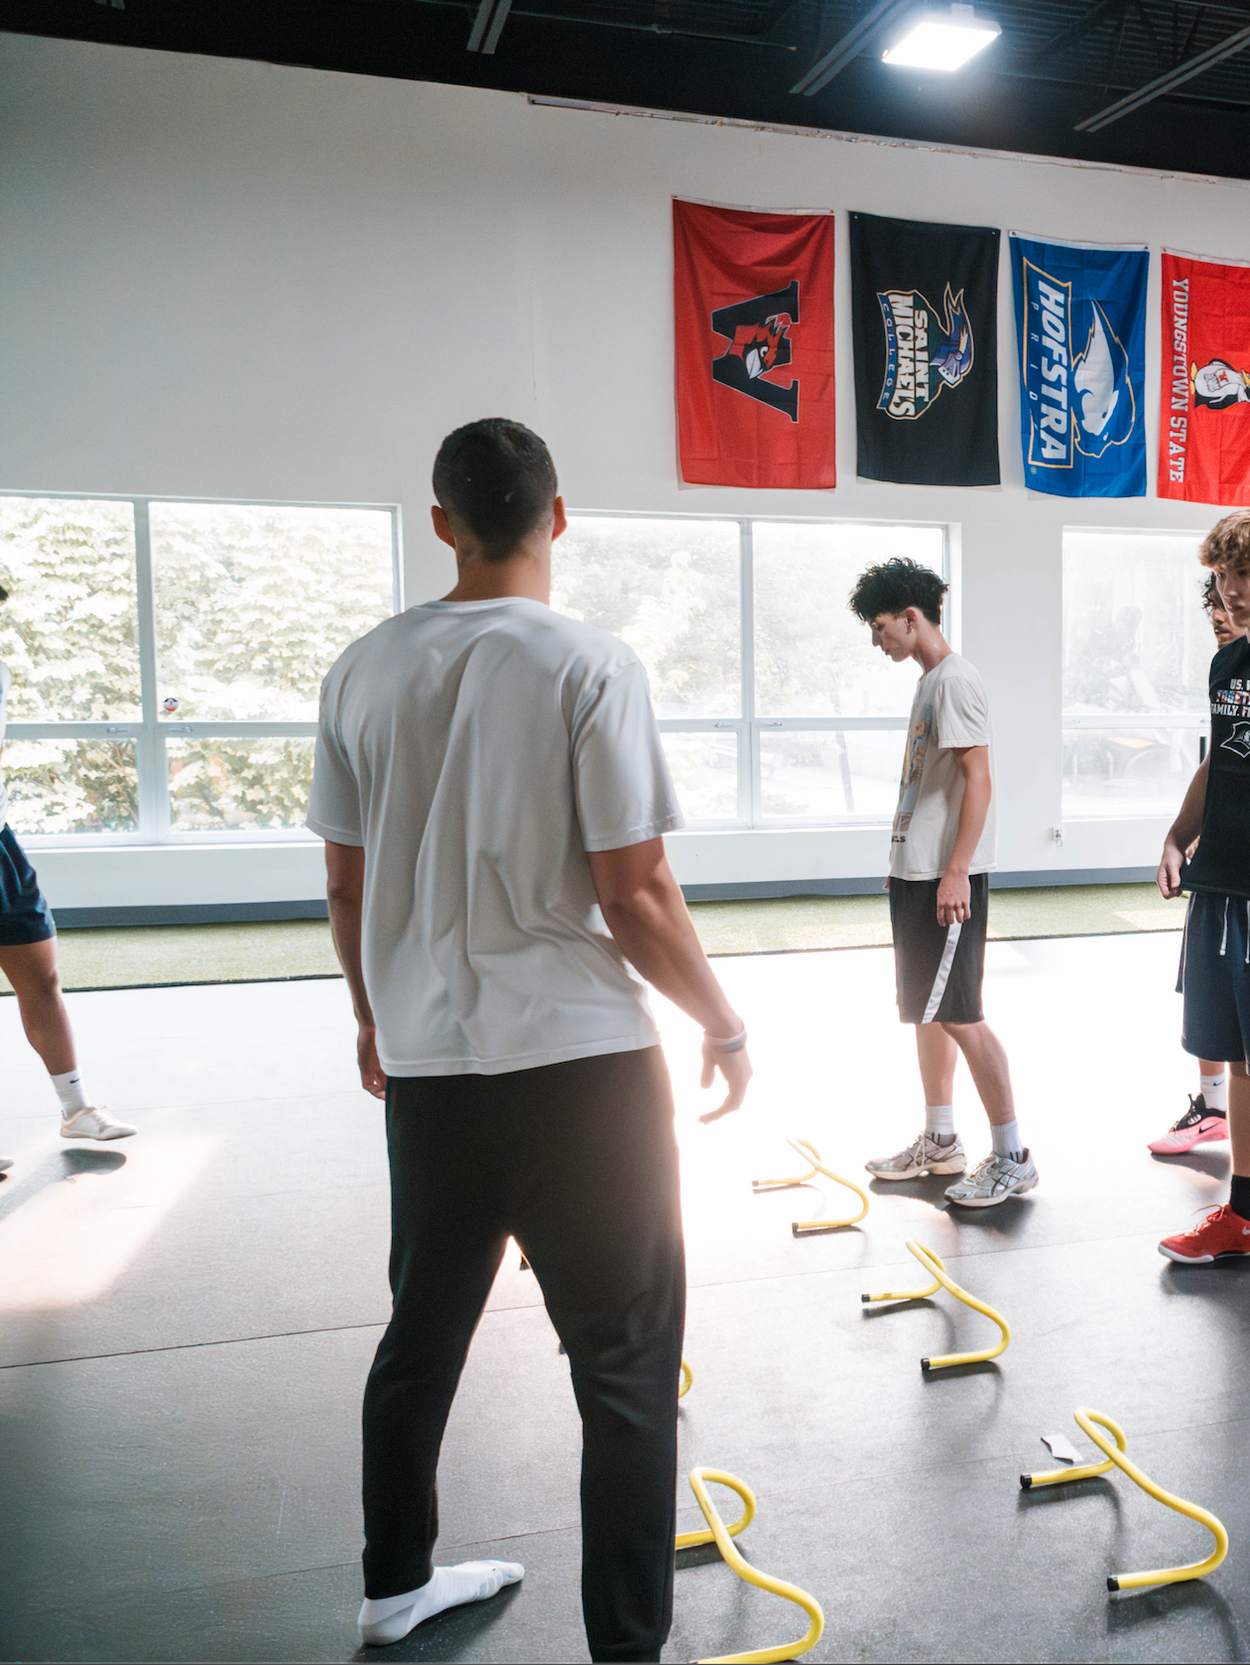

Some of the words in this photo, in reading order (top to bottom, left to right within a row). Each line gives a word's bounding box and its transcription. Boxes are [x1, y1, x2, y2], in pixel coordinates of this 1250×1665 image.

[883, 303, 896, 400] COLLEGE
[888, 294, 916, 416] MICHAELS
[914, 309, 929, 402] SAINT
[1029, 301, 1040, 430] PRID
[1038, 279, 1068, 460] HOFSTRA
[1171, 278, 1189, 411] YOUNGSTOWN
[1169, 416, 1188, 483] STATE
[1230, 678, 1243, 691] US.
